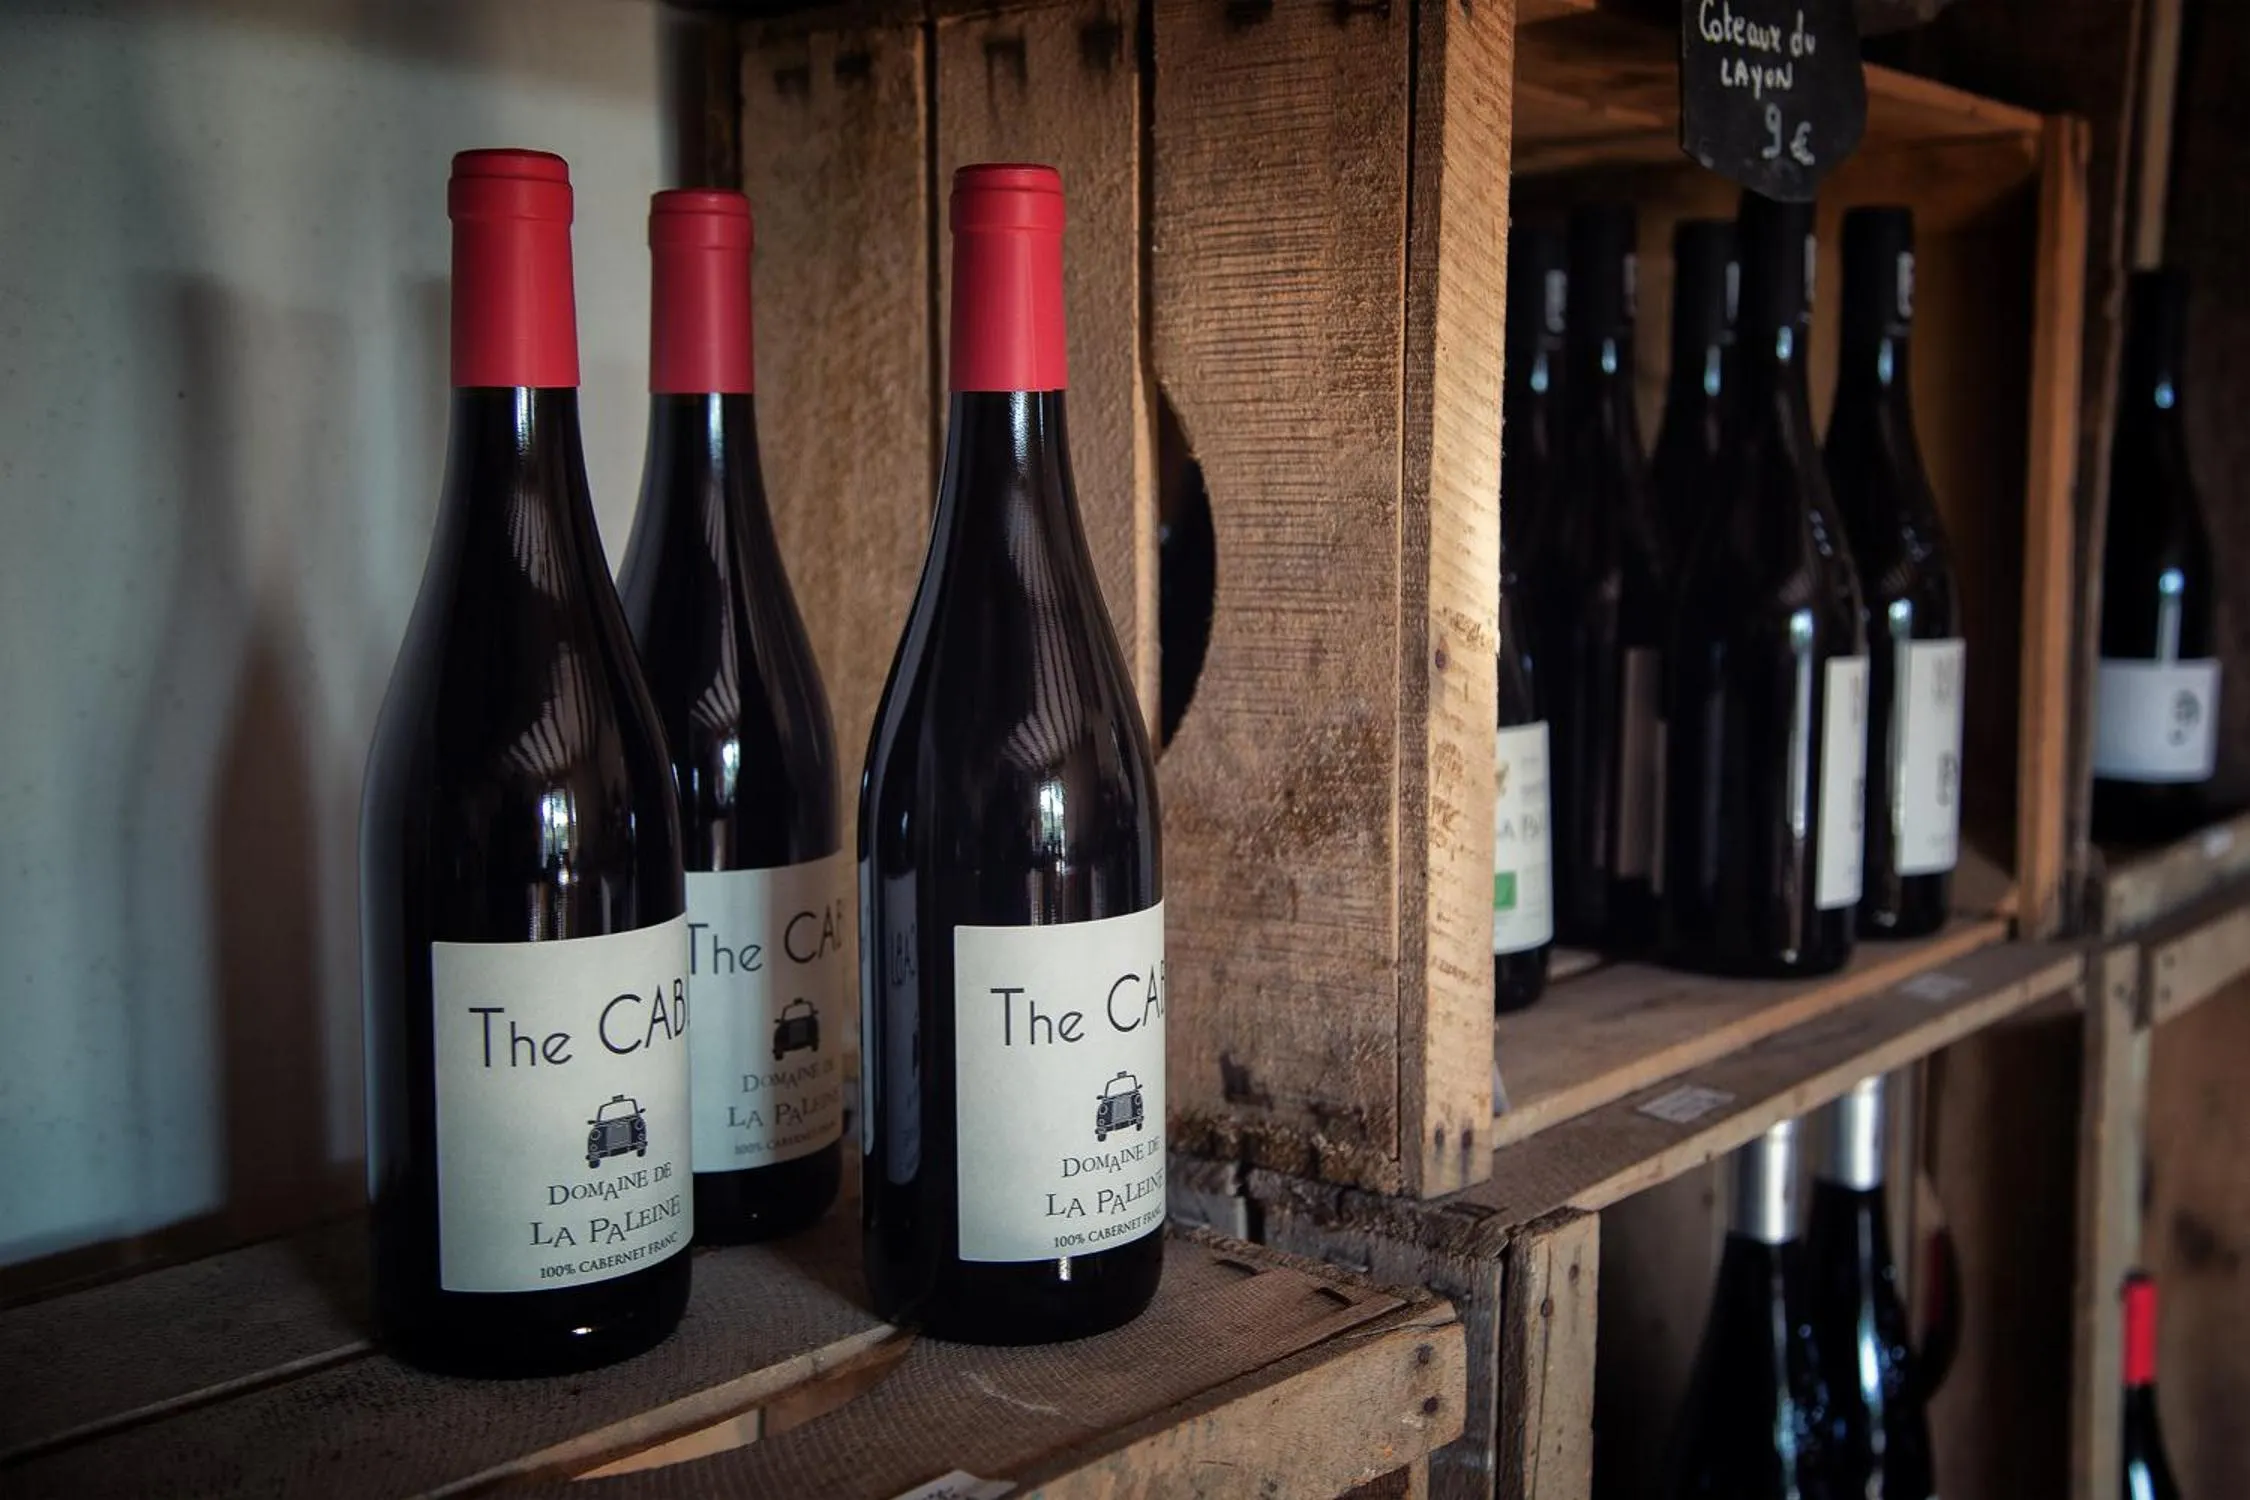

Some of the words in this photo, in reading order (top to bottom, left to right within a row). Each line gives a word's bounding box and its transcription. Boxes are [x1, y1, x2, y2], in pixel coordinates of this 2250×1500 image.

[1699, 0, 1781, 53] Coteaux
[1789, 9, 1816, 57] du
[1762, 103, 1782, 159] 9
[1790, 121, 1815, 165] €
[687, 922, 763, 975] The
[468, 1007, 573, 1067] The
[599, 978, 686, 1055] CAB
[990, 987, 1085, 1046] The
[728, 1106, 764, 1129] LA
[548, 1170, 649, 1206] DOMAINE
[653, 1161, 673, 1183] DE
[1061, 1144, 1145, 1178] DOMAINE
[529, 1221, 577, 1248] LA
[590, 1194, 681, 1245] PALEINE
[1044, 1193, 1087, 1219] LA
[540, 1264, 576, 1279] 100%
[579, 1245, 646, 1273] CABERNET
[647, 1231, 678, 1256] FRANC
[1054, 1234, 1085, 1248] 100%
[1088, 1215, 1142, 1243] CABERNET
